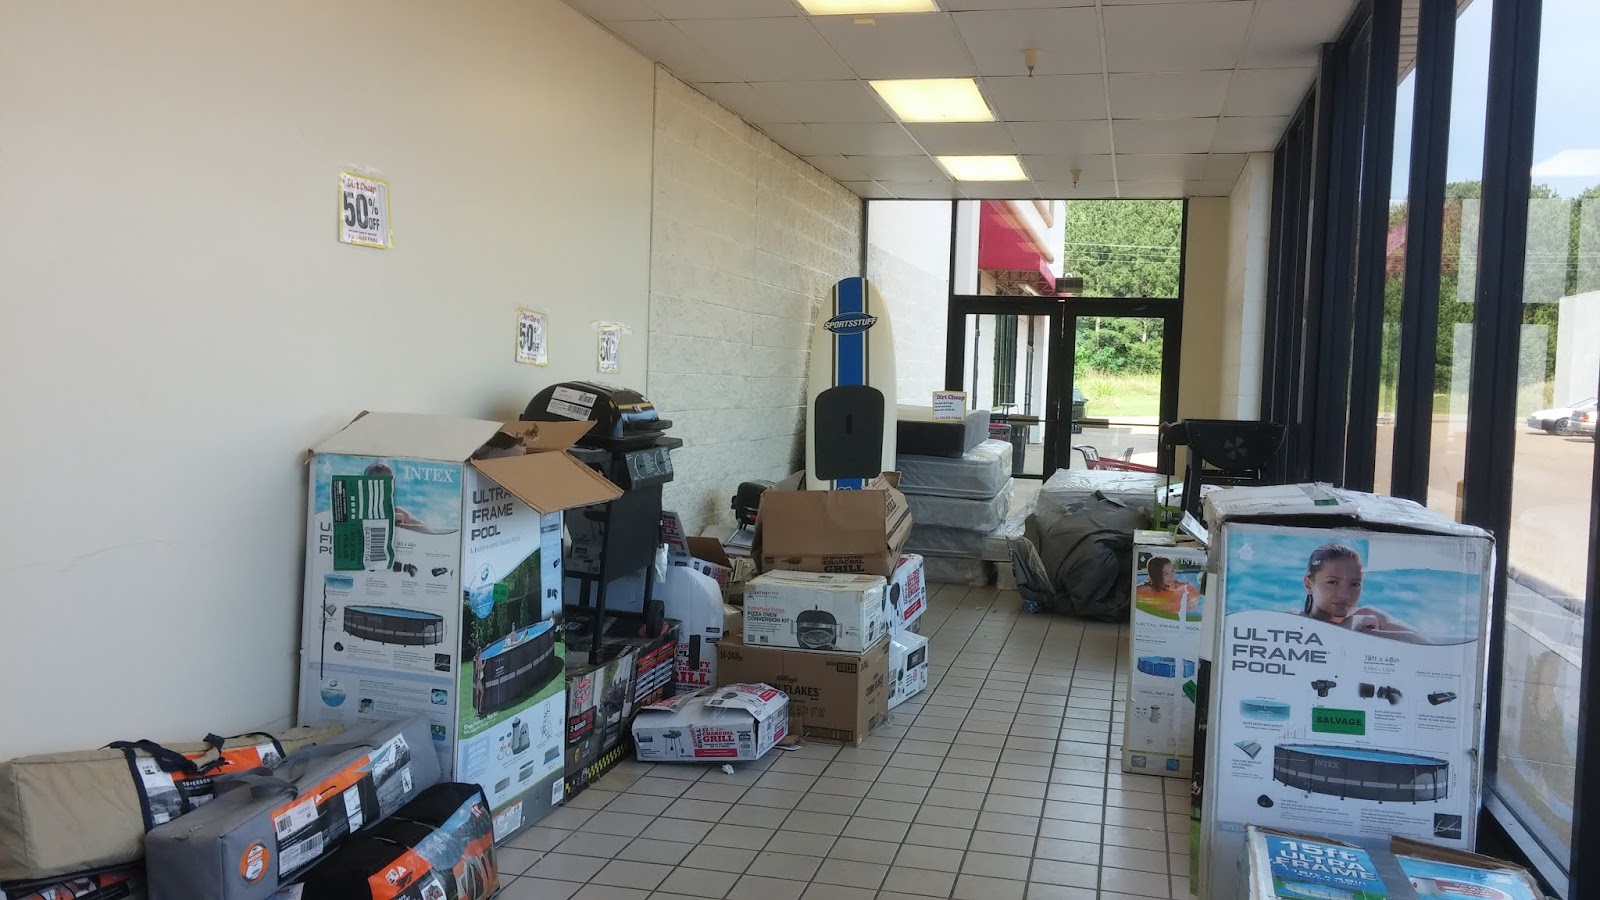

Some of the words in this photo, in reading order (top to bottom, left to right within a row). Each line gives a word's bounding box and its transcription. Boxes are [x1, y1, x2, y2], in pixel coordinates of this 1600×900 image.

[368, 217, 380, 231] OFF
[823, 316, 878, 331] SPORTSSTUFF
[404, 466, 455, 483] INTEX
[473, 487, 512, 504] ULTRA
[472, 503, 513, 524] FRAME
[471, 525, 501, 541] POOL
[824, 564, 865, 573] GRILL
[1233, 626, 1324, 647] ULTRA
[1232, 644, 1328, 664] FRAME
[1365, 654, 1378, 662] 18ft
[1384, 656, 1400, 664] 48in
[1231, 659, 1296, 676] POOL
[783, 684, 820, 697] FLAKES
[1316, 715, 1362, 727] SALVAGE
[1314, 759, 1339, 769] INTEX
[1280, 840, 1357, 862] 15ft
[1275, 856, 1377, 881] FRAME
[1280, 849, 1367, 872] ULTRA
